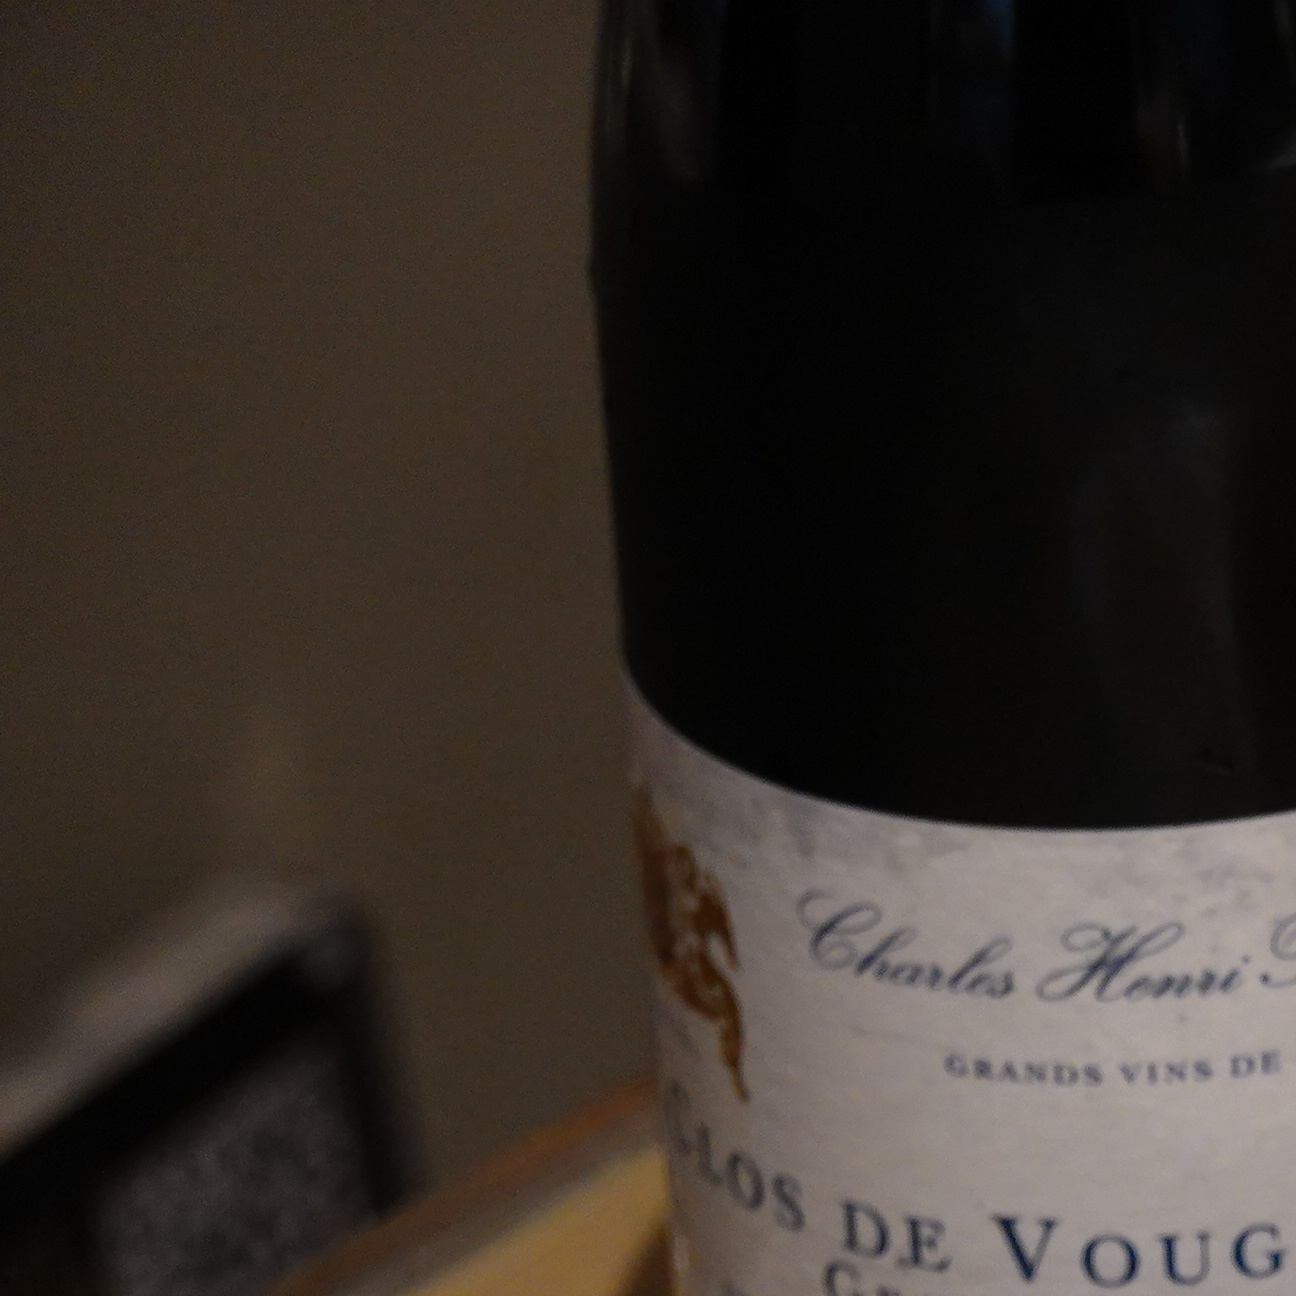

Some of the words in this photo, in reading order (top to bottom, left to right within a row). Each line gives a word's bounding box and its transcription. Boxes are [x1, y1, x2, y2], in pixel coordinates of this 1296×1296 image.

[797, 889, 1016, 1000] Charles
[1034, 920, 1251, 1003] Henri
[943, 1051, 1104, 1087] GRANDS
[1117, 1058, 1215, 1089] VINS
[1229, 1048, 1282, 1080] DE
[837, 1196, 952, 1274] DE
